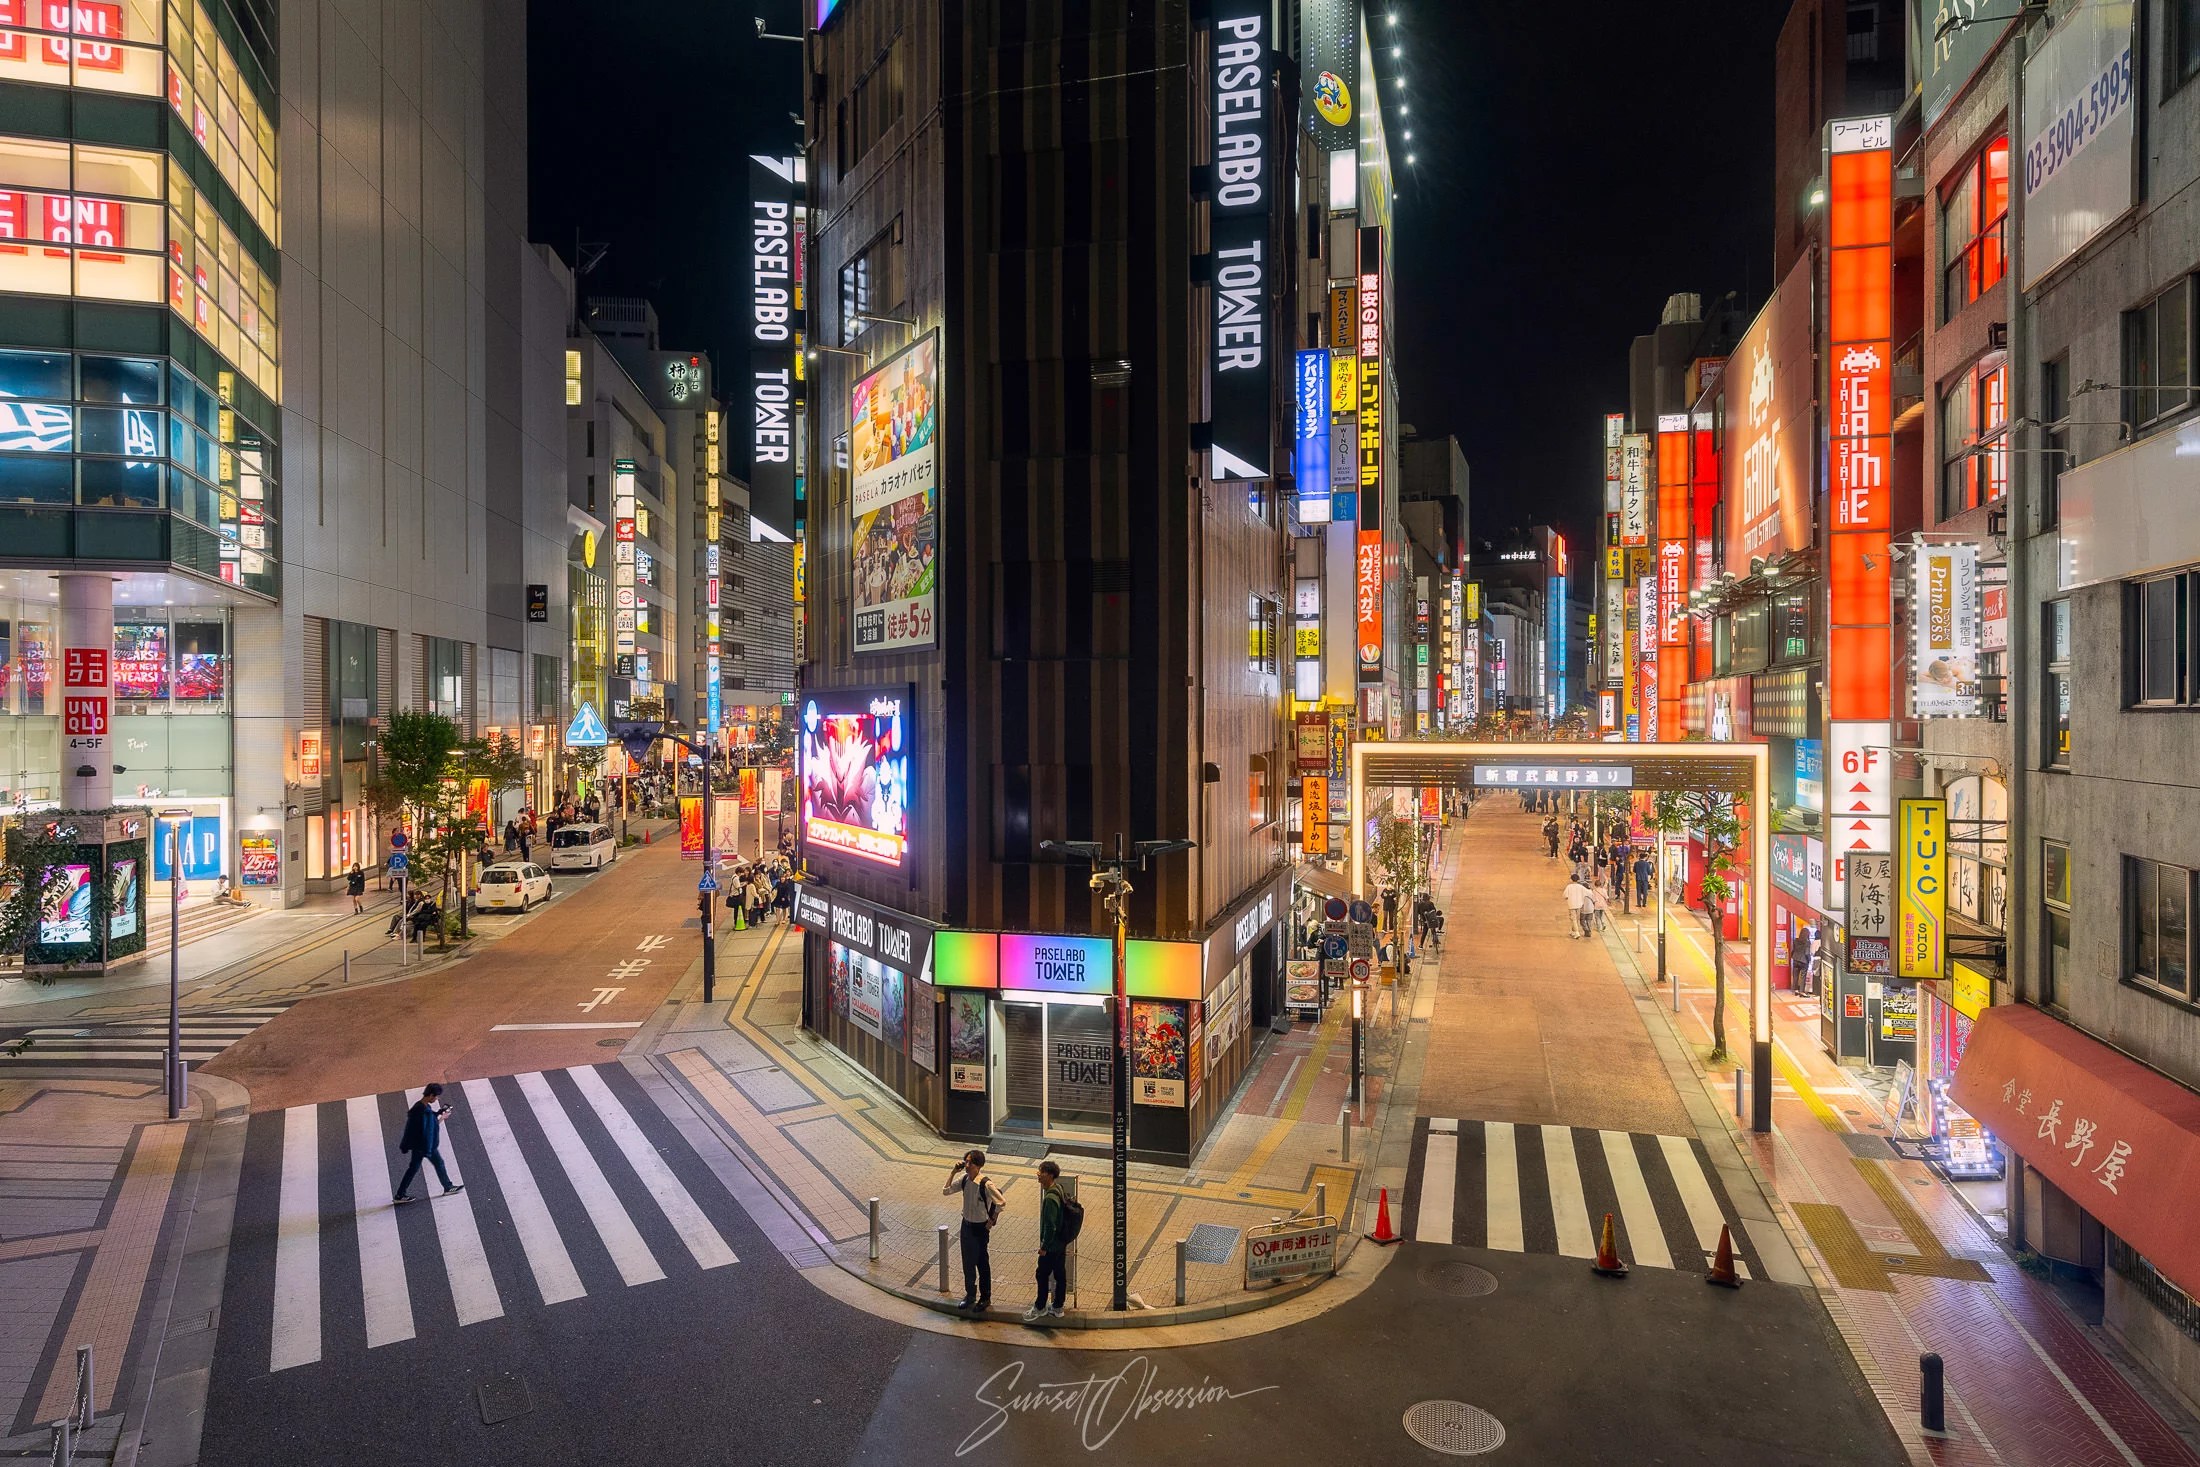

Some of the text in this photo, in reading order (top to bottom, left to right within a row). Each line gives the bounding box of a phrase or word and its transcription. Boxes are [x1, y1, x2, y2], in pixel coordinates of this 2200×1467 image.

[50, 5, 107, 34] UNI
[1834, 120, 1883, 135] ワールド
[2025, 48, 2131, 195] 03-5904-5995
[1862, 135, 1888, 148] ビル
[1217, 15, 1262, 372] PASELABO TOWER
[52, 198, 108, 225] UNI
[1361, 274, 1379, 357] 驚安の殿堂
[754, 200, 790, 464] PASELABO TOWER
[1304, 354, 1318, 440] アパマンショップ
[1360, 362, 1380, 486] ドン・キホーテ
[1839, 377, 1849, 524] TAITO STATION
[1851, 376, 1881, 524] GAME
[855, 459, 932, 505] PASELA カラオケパセラ
[1743, 418, 1782, 524] GAME
[1628, 536, 1639, 544] 5F
[1360, 544, 1374, 623] ベガスベガス
[1931, 566, 1947, 643] Princess
[618, 621, 633, 629] CRAB
[887, 602, 932, 641] 徒歩5分
[1960, 616, 1971, 646] 新宿店
[69, 653, 103, 667] ユニ
[120, 662, 158, 671] FOR NEW
[69, 669, 103, 683] クロ
[1957, 681, 1974, 696] 3F
[68, 701, 102, 715] UNI
[1304, 714, 1321, 724] 3F
[68, 717, 104, 732] QLO
[303, 759, 317, 767] UNI
[303, 766, 318, 774] QLO
[1843, 750, 1878, 774] 6F
[1485, 769, 1619, 783] 新宿武蔵野通り
[164, 832, 215, 874] GAP
[245, 855, 276, 871] 25TH
[1811, 862, 1823, 883] EXB
[1859, 884, 1886, 934] 海神
[832, 904, 912, 965] PASELABO TOWER
[1234, 906, 1258, 954] PASELABO
[1856, 939, 1883, 950] Pizza
[1917, 923, 1928, 962] SHOP
[1034, 947, 1086, 963] PASELABO
[1035, 962, 1086, 982] TOWER
[1355, 965, 1368, 976] 30
[1056, 1042, 1113, 1062] PASELAB
[954, 1071, 966, 1080] 15
[1143, 1085, 1156, 1095] 15
[2001, 1077, 2133, 1196] 食堂 長野屋
[1116, 1184, 1124, 1247] RAMBLING
[1269, 1232, 1332, 1254] 車両通行止
[1116, 1255, 1124, 1287] ROAD
